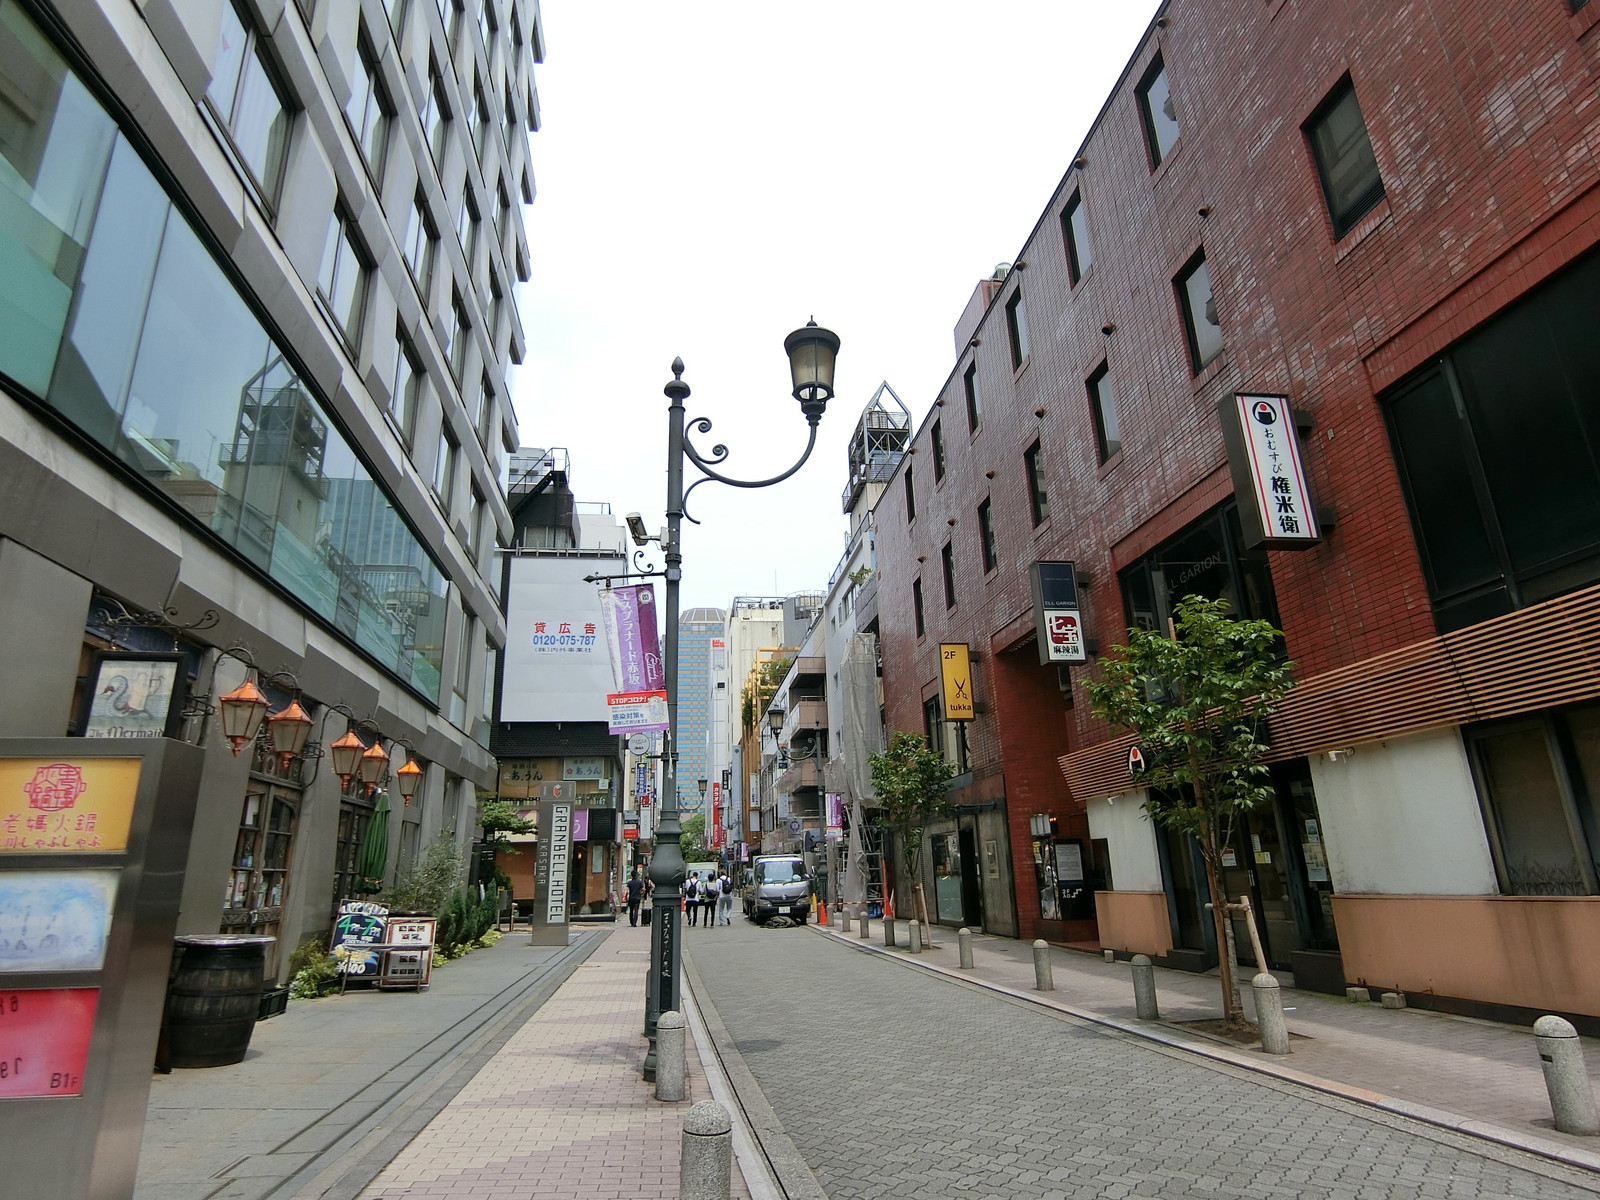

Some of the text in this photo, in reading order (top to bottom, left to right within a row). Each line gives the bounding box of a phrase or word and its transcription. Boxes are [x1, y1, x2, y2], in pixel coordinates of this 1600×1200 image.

[1264, 428, 1300, 533] おむすび 権米衛
[1179, 552, 1221, 584] GARION
[534, 622, 596, 634] 貸広告
[533, 635, 596, 645] 0120-075-787
[619, 591, 641, 685] エスプラナード赤坂
[944, 650, 956, 660] 2F
[1053, 645, 1079, 654] 麻辣湯
[107, 726, 164, 738] Mermaid
[3, 812, 98, 834] 老媽火鍋
[537, 838, 549, 885] AKASAKA
[549, 806, 568, 921] GRANBELL HOTEL
[50, 1072, 80, 1089] B1F
